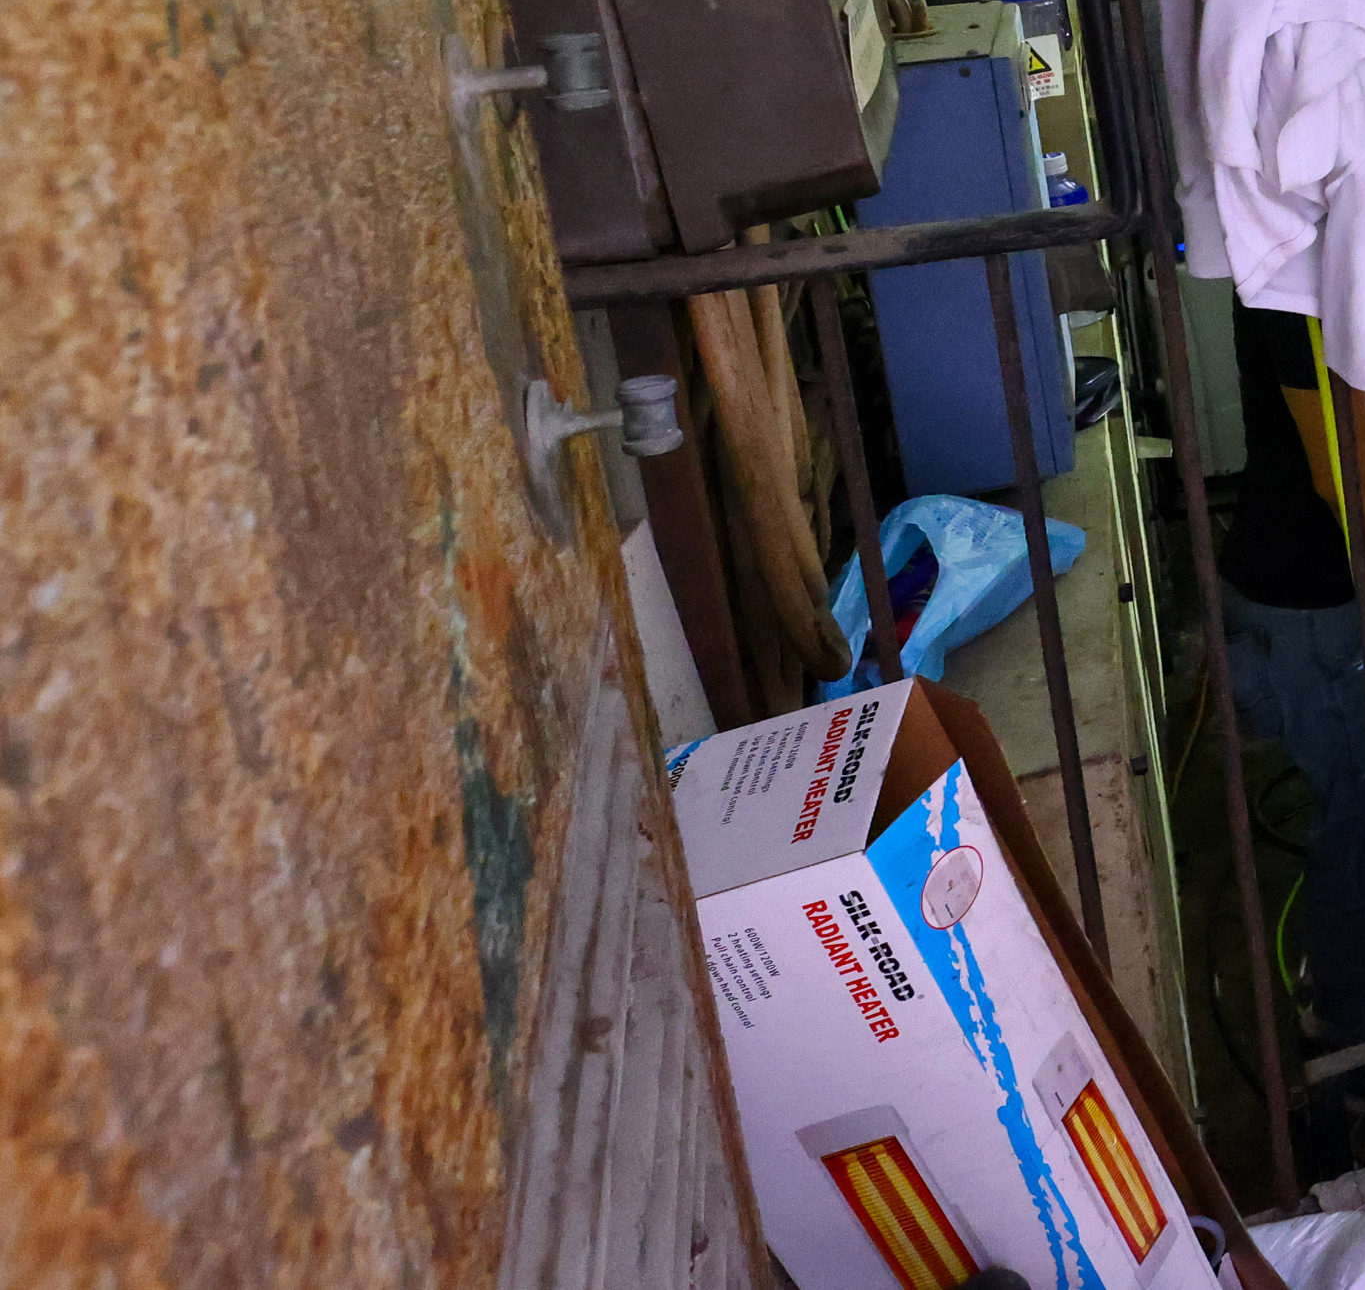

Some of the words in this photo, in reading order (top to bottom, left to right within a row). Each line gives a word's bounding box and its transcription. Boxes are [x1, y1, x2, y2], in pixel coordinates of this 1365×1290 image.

[759, 746, 773, 767] chain
[768, 730, 779, 746] Pull
[774, 731, 792, 761] heating
[815, 708, 853, 774] RADIANT
[834, 701, 879, 804] SILK-ROAD
[721, 757, 740, 792] mounted
[741, 753, 757, 774] down
[747, 768, 764, 796] control
[761, 761, 778, 793] settings
[733, 773, 748, 796] head
[721, 796, 738, 826] control
[791, 776, 831, 845] HEATER
[744, 927, 781, 978] 600W/1200W
[839, 890, 915, 1002] SILK-ROAD
[711, 937, 727, 954] Pull
[720, 952, 736, 976] chain
[733, 975, 757, 1003] control
[731, 937, 752, 970] heating
[750, 967, 773, 1000] settings
[802, 900, 864, 976] RADIANT
[845, 976, 900, 1043] HEATER
[719, 981, 738, 1003] head
[731, 1001, 755, 1029] control
